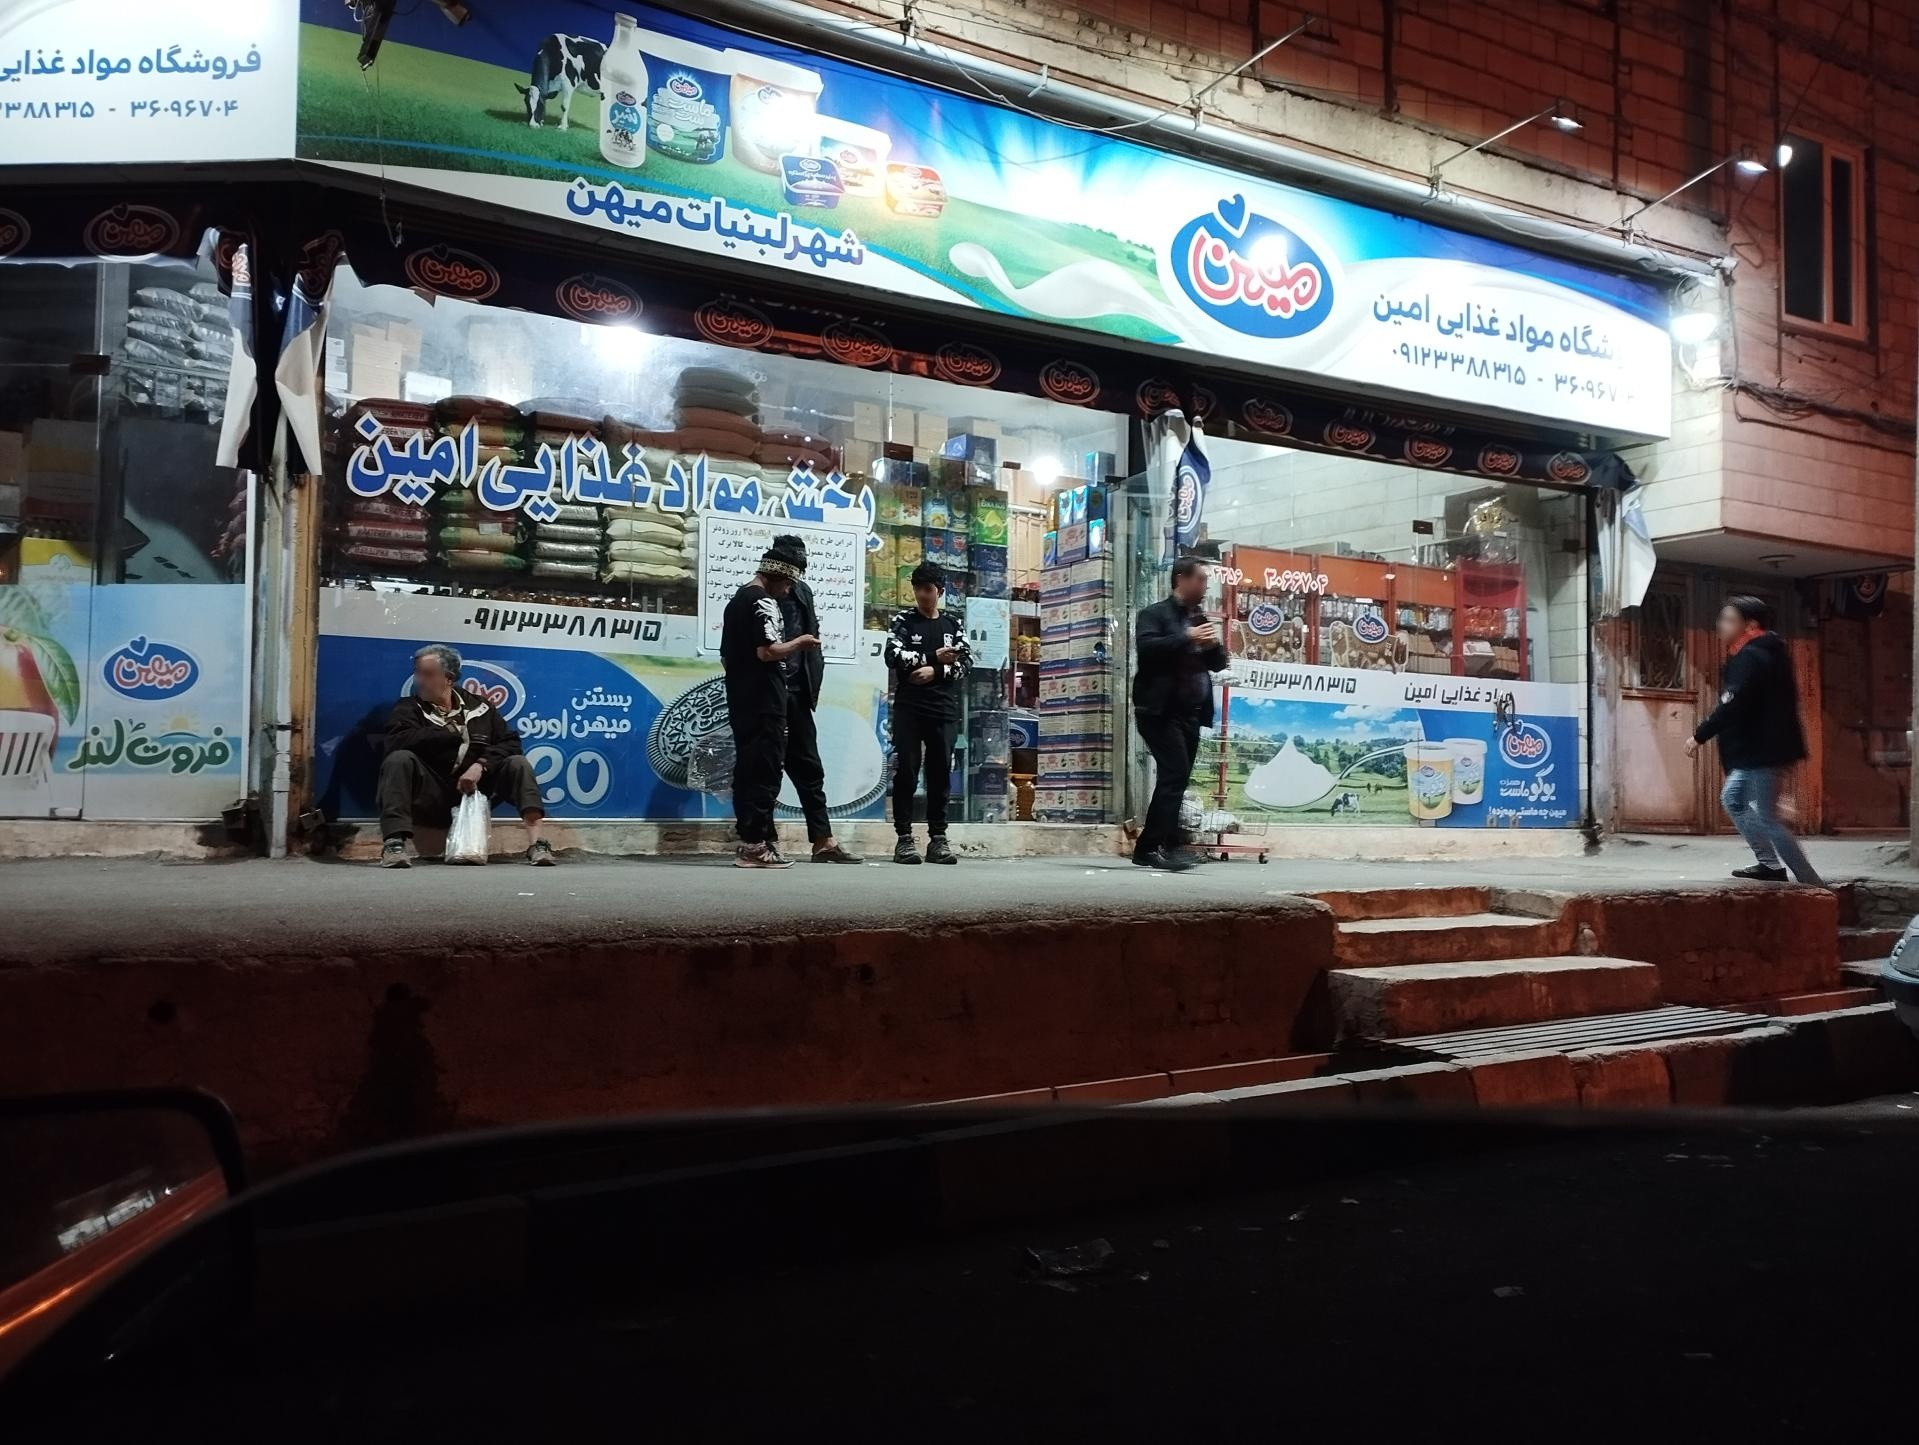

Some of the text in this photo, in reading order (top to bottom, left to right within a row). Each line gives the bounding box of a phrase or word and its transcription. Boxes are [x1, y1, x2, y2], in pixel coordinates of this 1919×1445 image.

[72, 49, 131, 80] مواد
[138, 43, 262, 80] فروشگاه
[0, 101, 95, 119] ۳۸۸۳۱۵
[130, 99, 238, 118] ۳۶۰۹۶۷۰۴
[611, 107, 638, 125] شیر
[566, 180, 864, 268] شهر لبنیات میهن
[1188, 226, 1322, 318] میهن
[1373, 293, 1430, 326] امین
[1436, 302, 1501, 339] غذایی
[1505, 314, 1554, 352] مواد
[1392, 341, 1527, 386] ۰۹۱۲۳۳۸۸۳۱۵
[346, 411, 480, 506] امین
[477, 429, 655, 523] غذایی
[659, 450, 763, 517] مواد
[464, 606, 662, 642] ۰۹۱۲۳۳۸۸۳۱۵
[113, 655, 192, 690] میهن
[571, 686, 632, 712] بستنی
[1404, 682, 1438, 703] امین
[1441, 685, 1481, 706] غذایی
[570, 713, 631, 739] میهن
[1506, 733, 1544, 758] میهن
